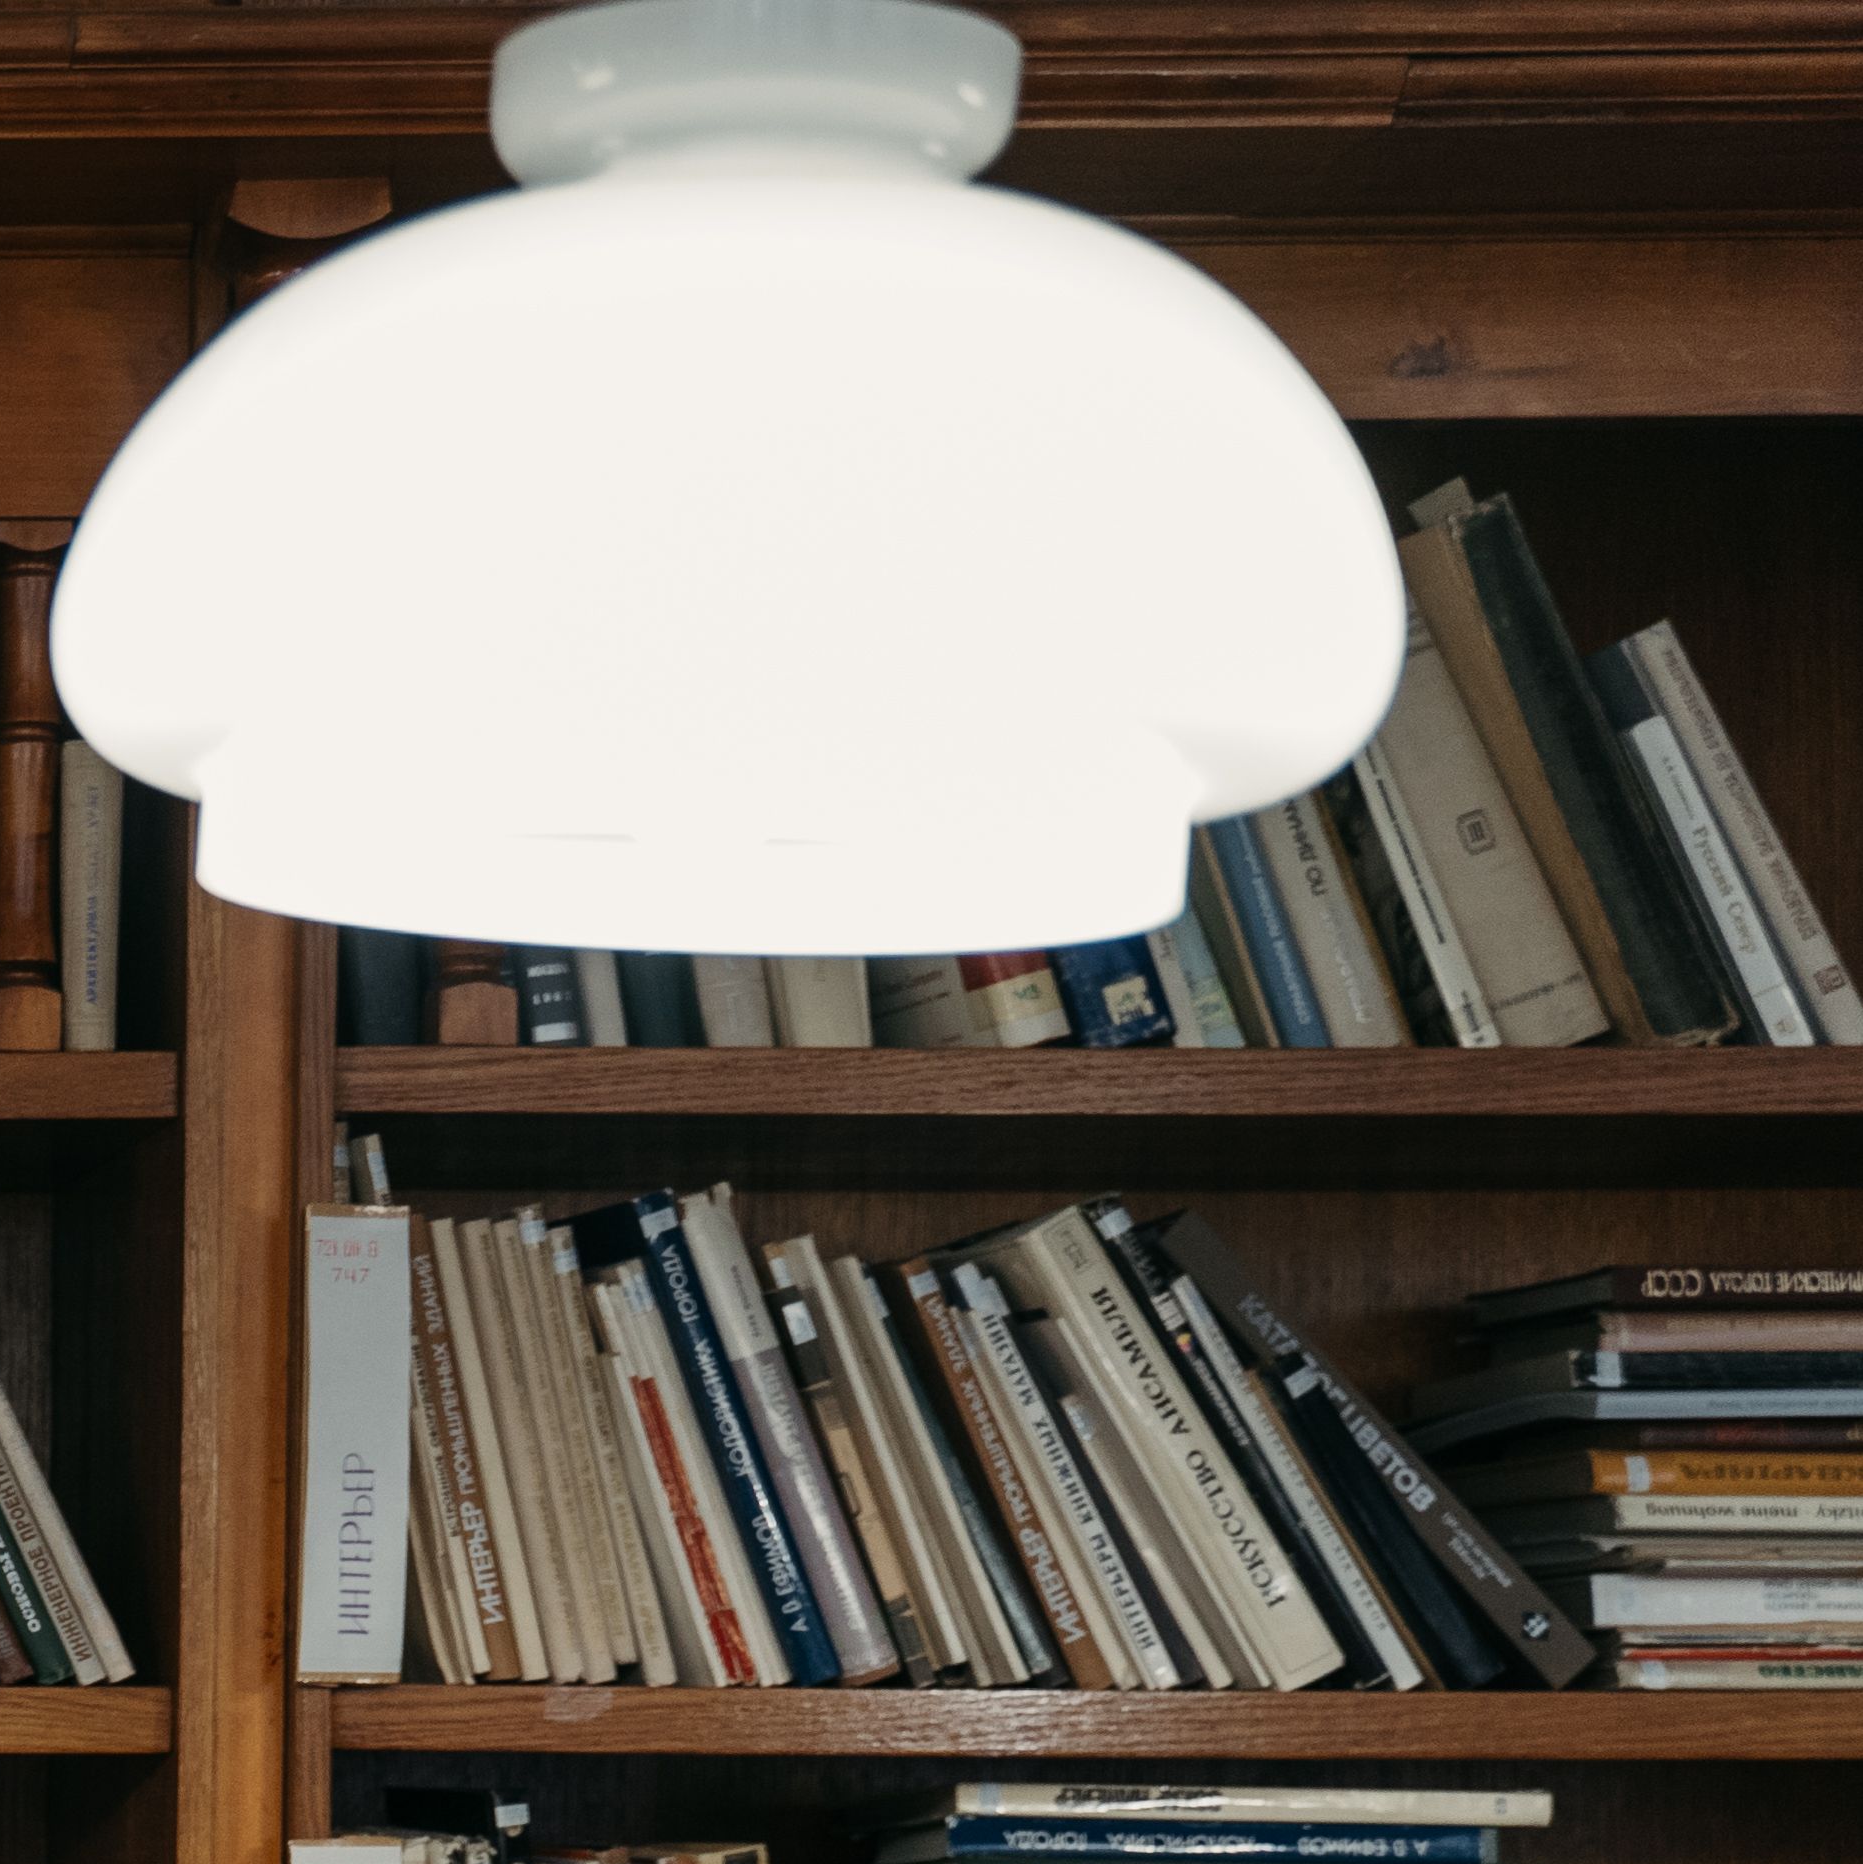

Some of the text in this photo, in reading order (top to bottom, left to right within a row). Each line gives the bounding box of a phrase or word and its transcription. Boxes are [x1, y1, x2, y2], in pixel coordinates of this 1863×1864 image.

[337, 1452, 374, 1635] ИНТЕРЬЕР
[410, 1253, 505, 1624] ИНТЕРЬЕР ПРОМЫШЛЕННЫХ ЗДАНИЙ
[1088, 1282, 1286, 1609] ИСКУССТВО АНСАМБЛЯ
